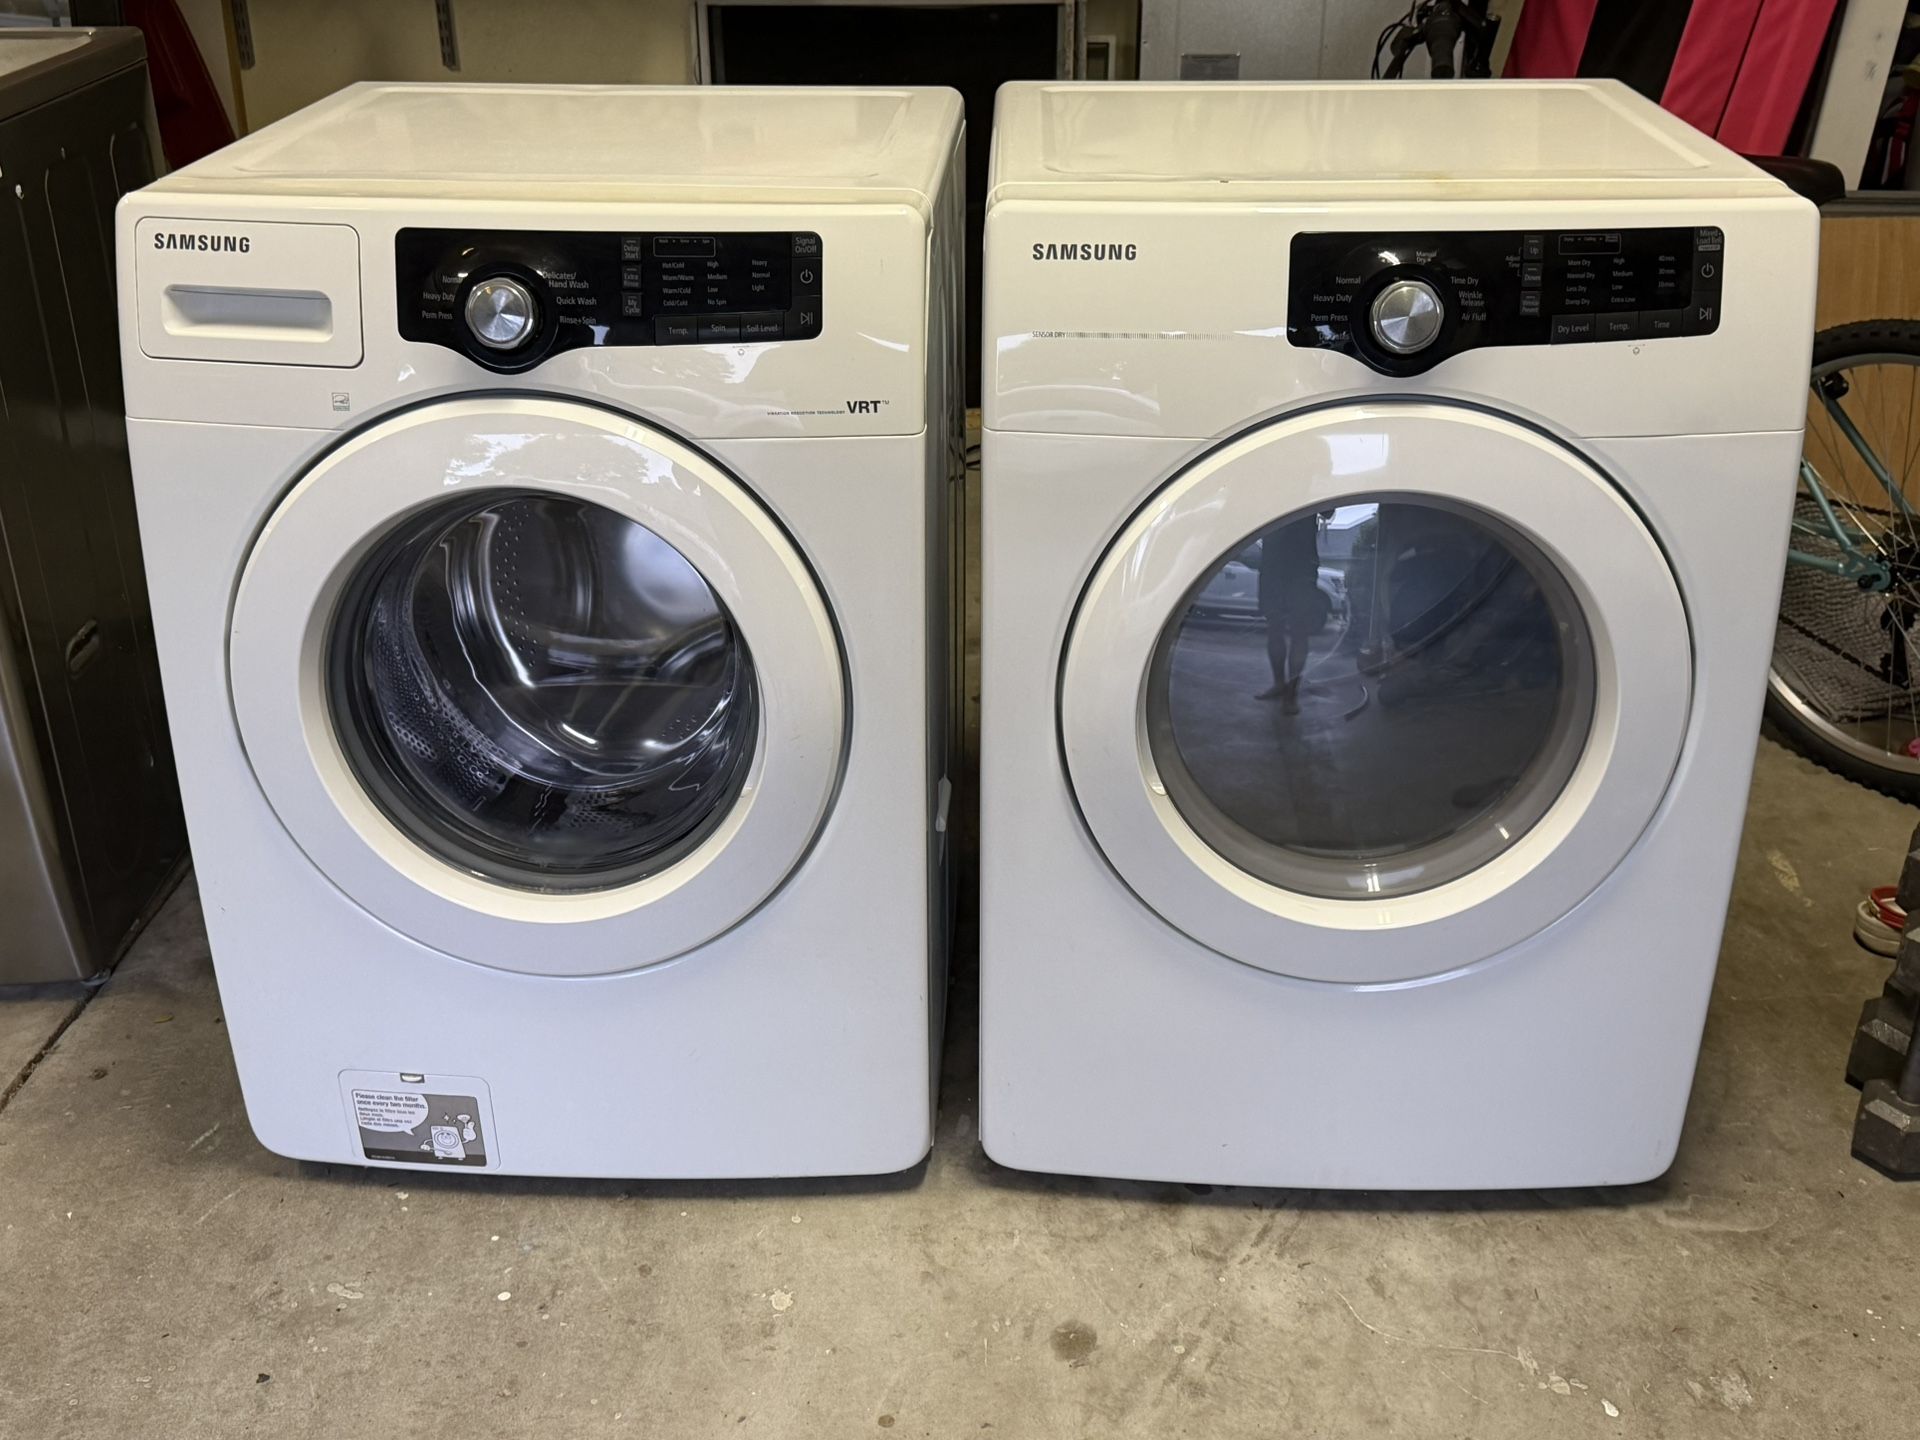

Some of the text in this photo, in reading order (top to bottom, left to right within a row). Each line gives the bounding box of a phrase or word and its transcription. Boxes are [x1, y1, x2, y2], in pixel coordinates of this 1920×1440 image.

[154, 233, 250, 253] SAMSUNG
[795, 237, 816, 246] Signal
[795, 245, 817, 254] On/Off
[1032, 243, 1137, 261] SAMSUNG
[549, 280, 589, 289] Hand Wash
[1336, 276, 1361, 284] Normal
[1450, 276, 1479, 286] Time Dry
[423, 292, 455, 303] Heavy Duty
[1313, 293, 1353, 303] Heavy Duty
[1459, 290, 1483, 299] Wrinkle
[556, 296, 597, 306] Quick Wash
[1460, 299, 1485, 307] Release
[422, 310, 453, 320] Perm Press
[1310, 313, 1349, 321] Perm Press
[1461, 312, 1487, 321] Air Fluff
[711, 324, 726, 333] Spin
[746, 324, 778, 333] Soil Level
[1557, 323, 1589, 335] Dry Level
[1609, 322, 1630, 332] Temp.
[1654, 320, 1671, 329] Time
[668, 327, 689, 336] Temp.
[1032, 330, 1053, 338] SENSOR
[355, 1092, 375, 1100] Please
